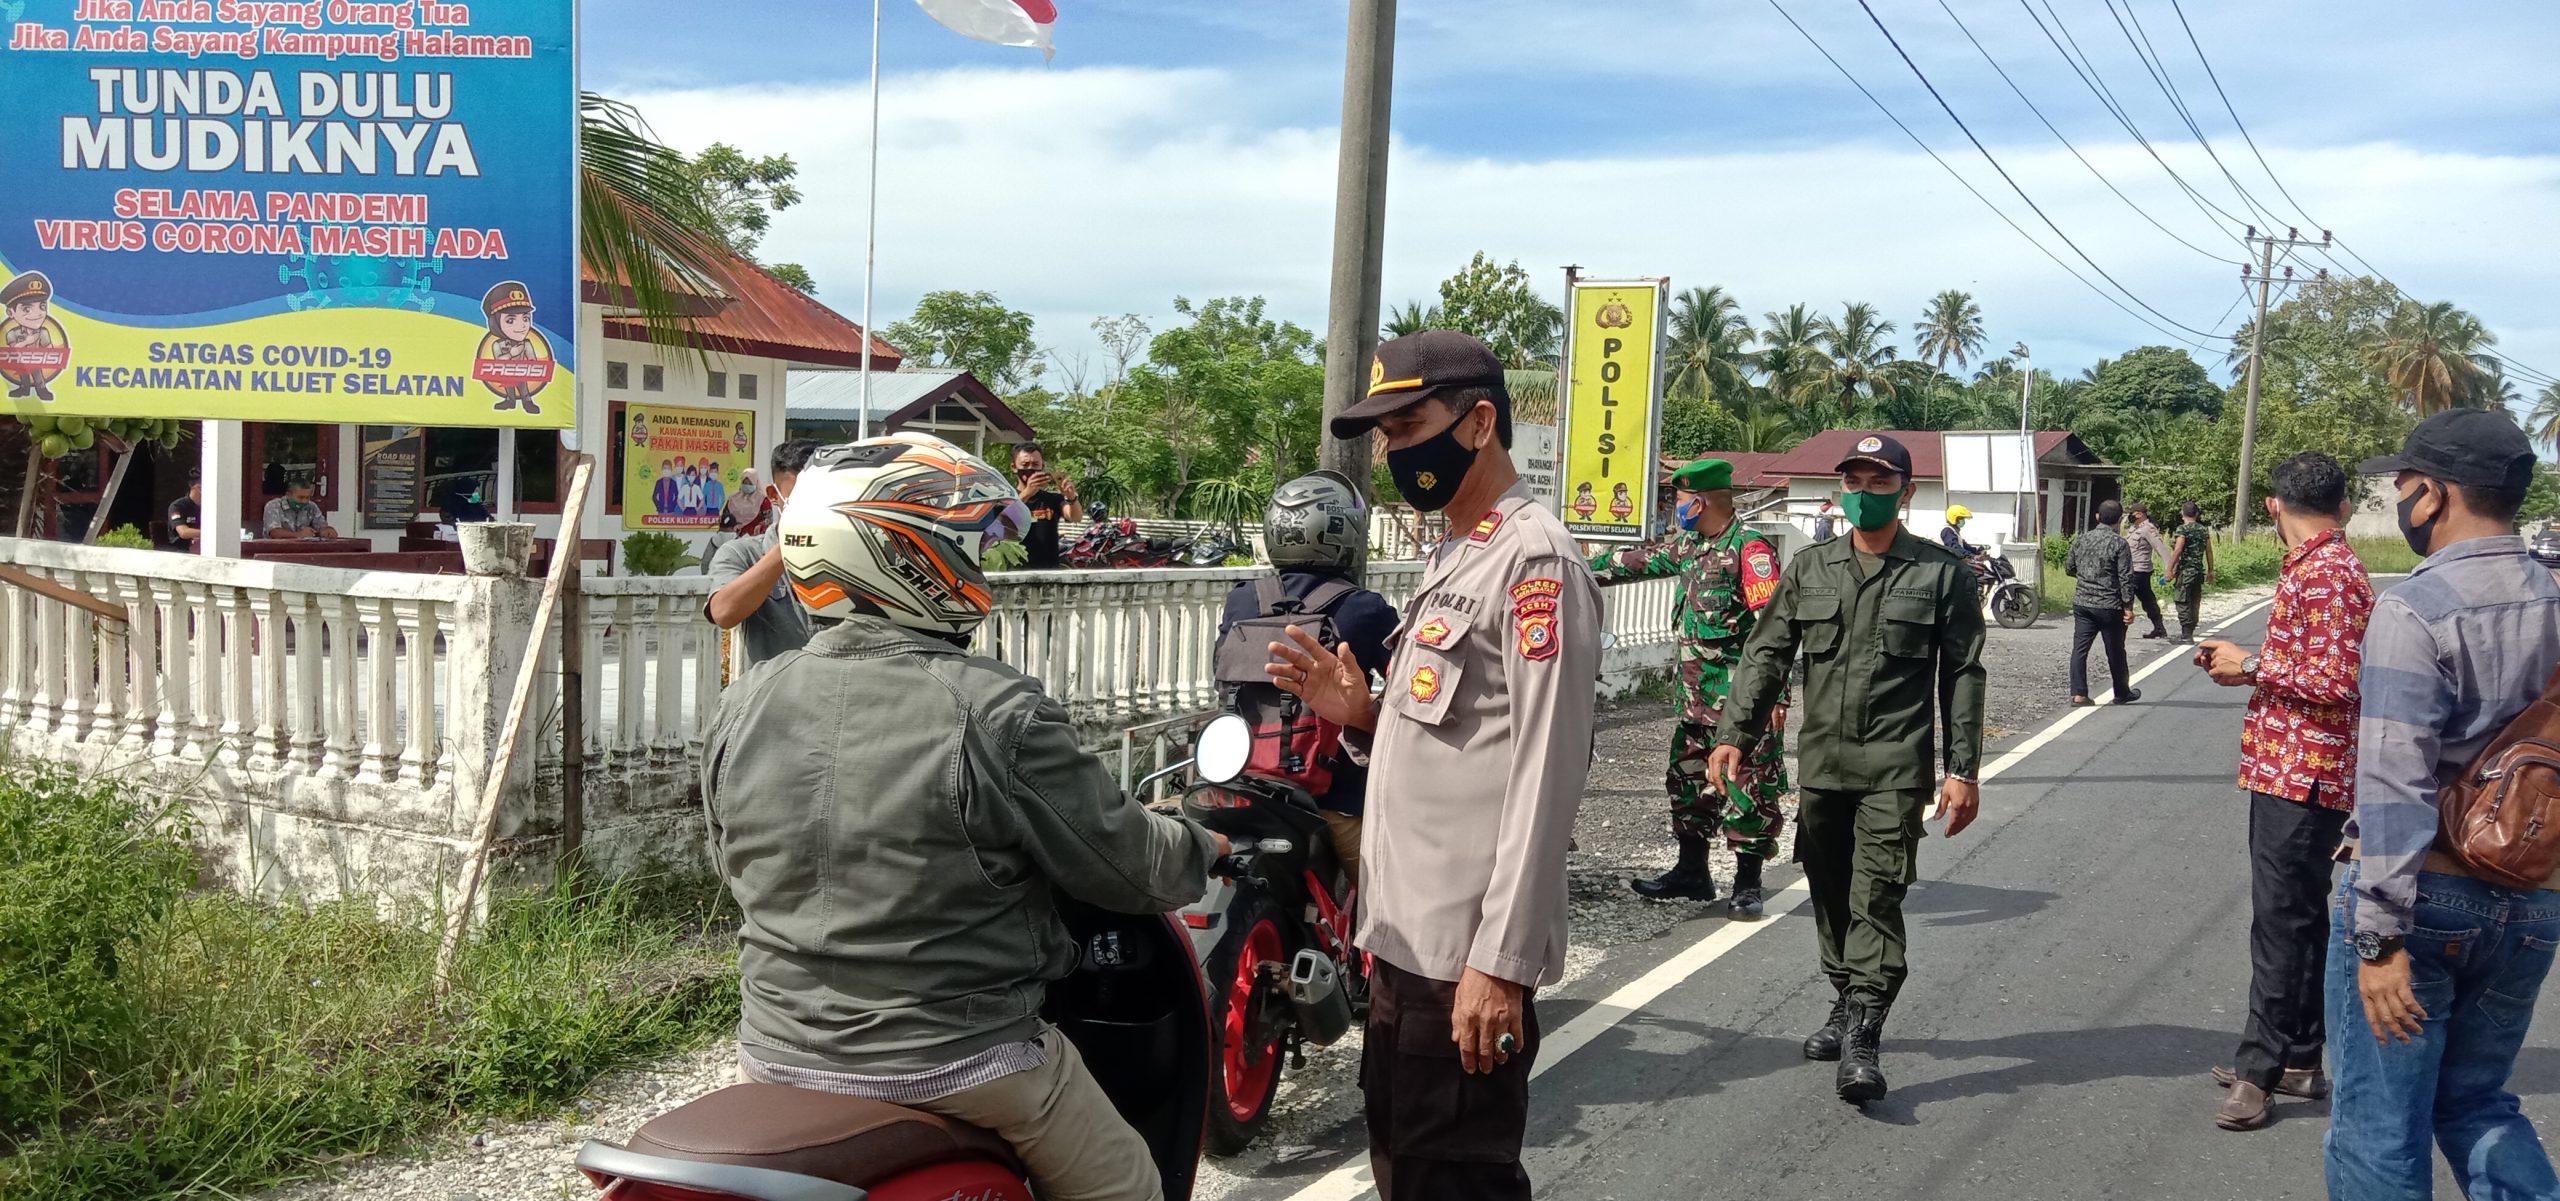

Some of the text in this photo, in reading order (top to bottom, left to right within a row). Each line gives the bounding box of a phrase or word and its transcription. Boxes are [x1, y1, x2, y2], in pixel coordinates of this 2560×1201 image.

[74, 0, 470, 29] Jika Anda Sayang Orang Tua
[11, 24, 532, 61] Jika Anda Sayang Kampung Halaman
[90, 67, 452, 119] TUNDA DULU
[62, 116, 480, 176] MUDIKNYA
[115, 188, 427, 224] SELAMA PANDEMI
[35, 219, 508, 259] VIRUS CORONA MASIH ADA
[149, 342, 391, 368] SATGAS COVID-19
[76, 366, 464, 397] KECAMATAN KLUET SELATAN
[480, 363, 548, 377] PRESISI
[1598, 337, 1623, 478] POLISI
[652, 415, 730, 428] ANDA MEMASUKI
[660, 427, 722, 438] KAWASAN WAJIB
[651, 438, 730, 453] PAKAI MASKER
[648, 516, 675, 524] POLSEK
[676, 516, 698, 524] KLUET
[1569, 524, 1590, 532] POLSEK
[1611, 526, 1636, 534] SELATAN
[1513, 580, 1557, 599] POLRES
[1430, 592, 1477, 615] POLRI
[1520, 602, 1549, 614] ACEH
